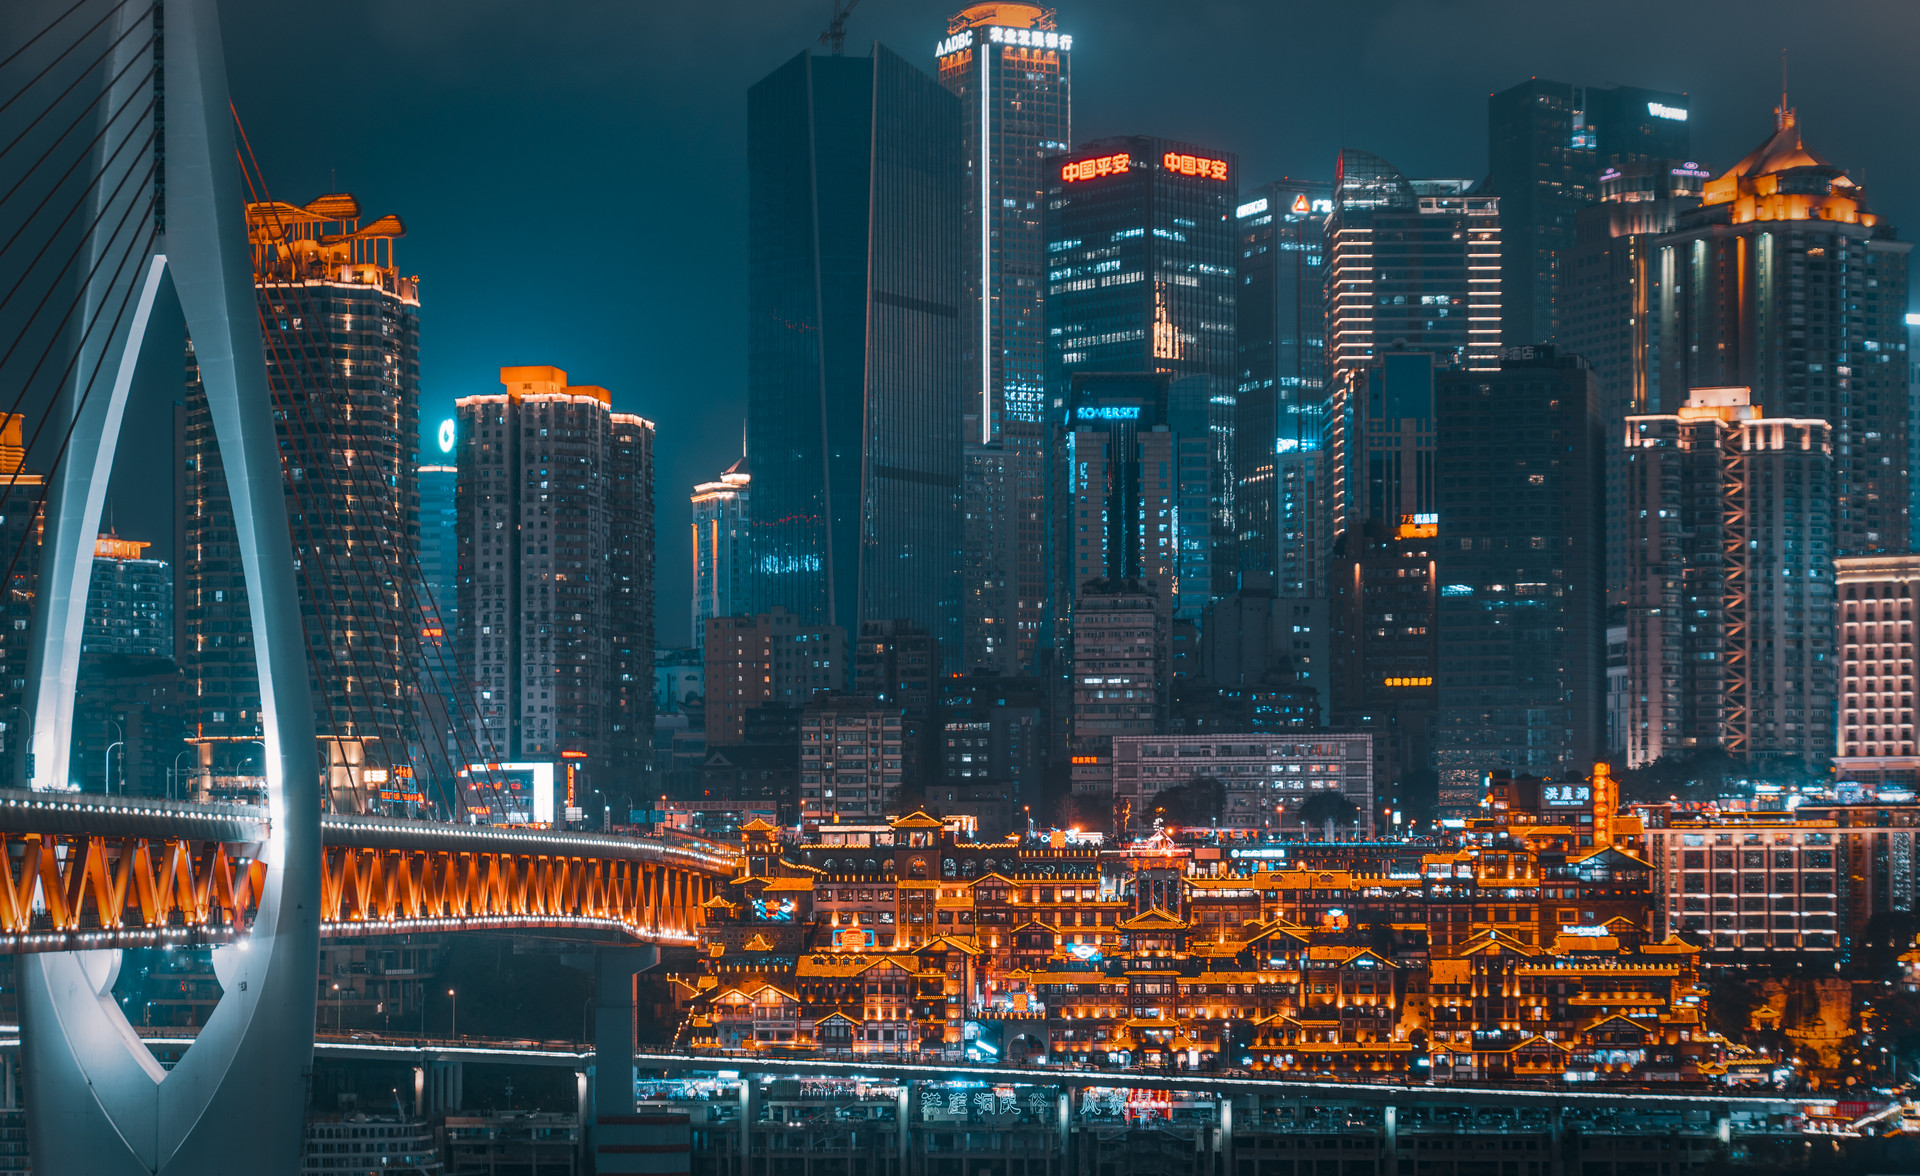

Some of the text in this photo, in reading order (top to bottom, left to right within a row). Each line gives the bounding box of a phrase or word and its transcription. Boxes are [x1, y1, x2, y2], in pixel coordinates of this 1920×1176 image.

[1062, 153, 1130, 183] 中国平安
[1163, 152, 1228, 181] 中国平安
[1077, 407, 1140, 419] SOMERSET
[1544, 786, 1590, 800] 洪崖洞
